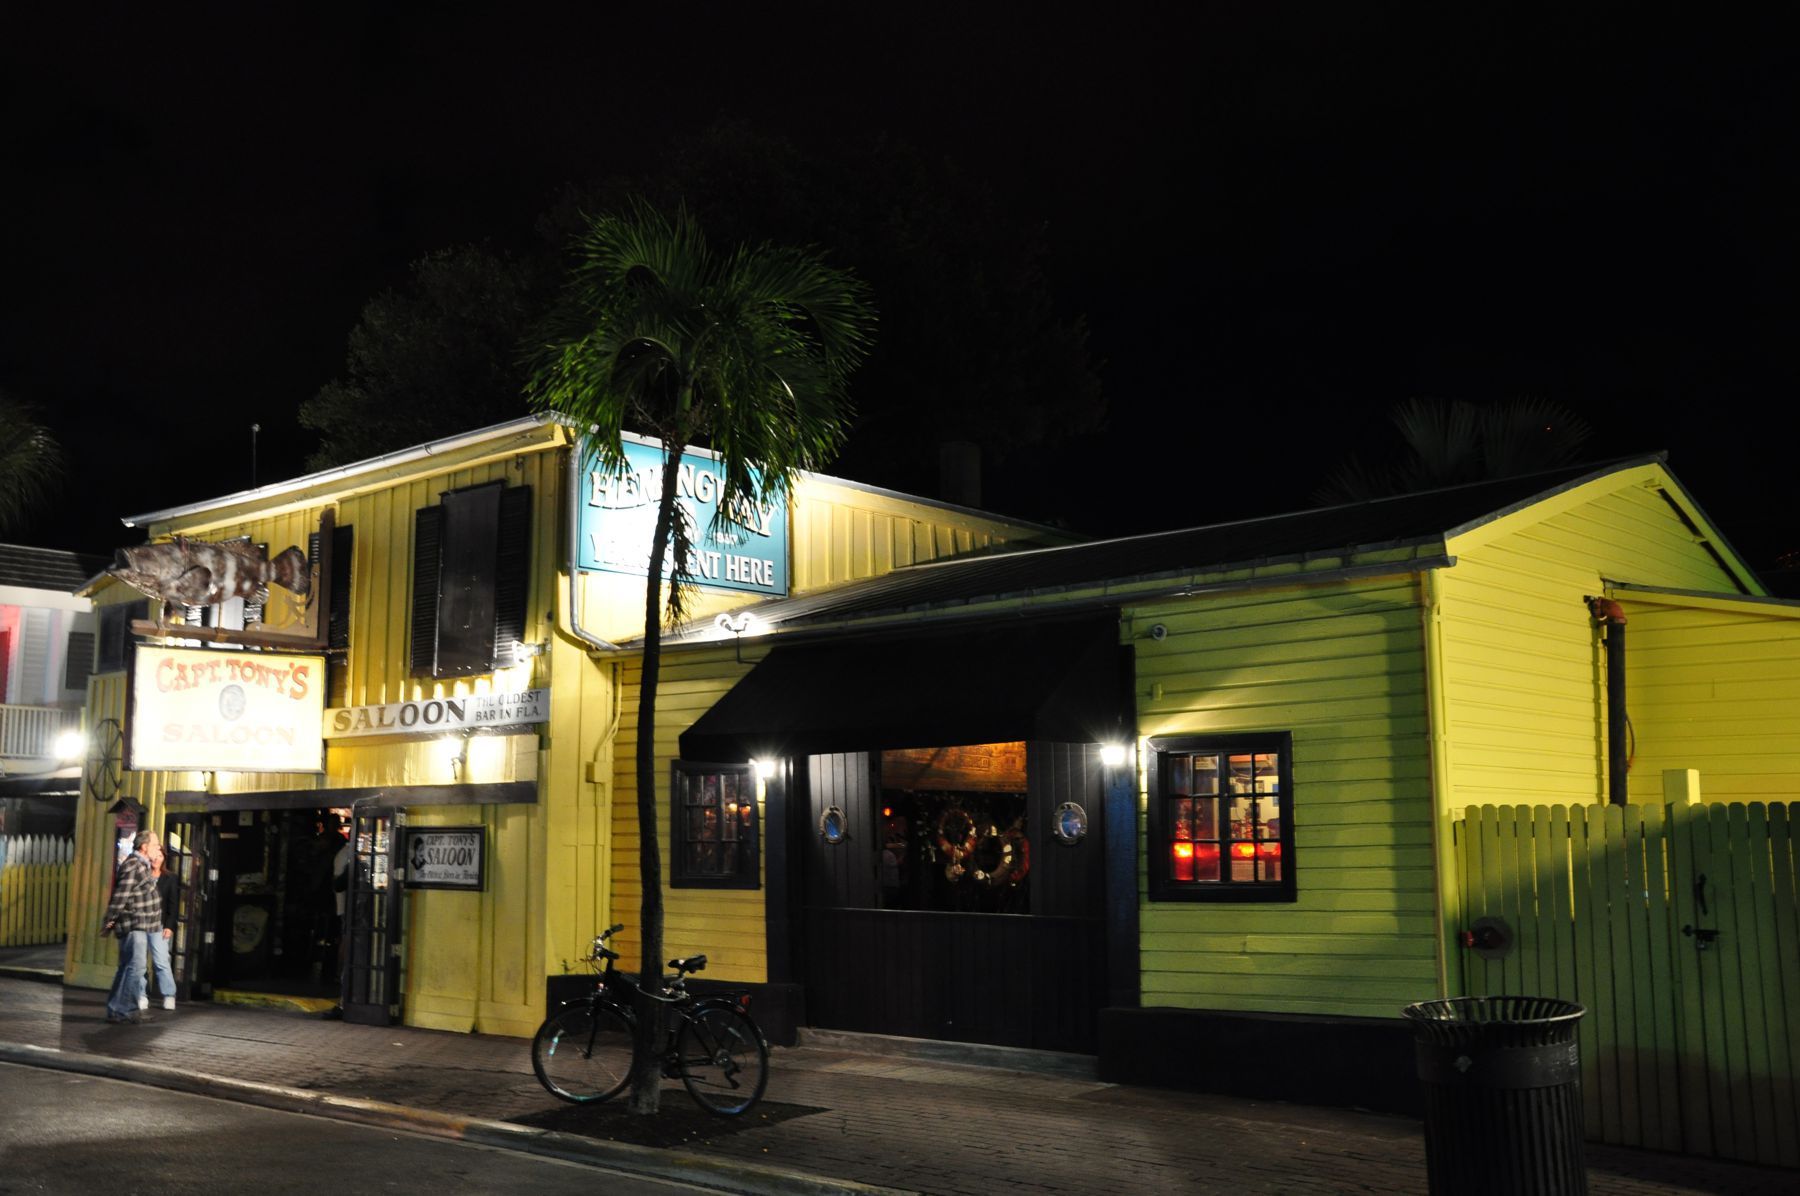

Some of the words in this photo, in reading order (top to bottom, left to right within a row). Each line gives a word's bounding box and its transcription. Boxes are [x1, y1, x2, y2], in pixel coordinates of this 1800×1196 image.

[724, 554, 775, 586] HERE
[155, 657, 222, 693] CAPT.
[225, 658, 310, 701] TONY'S
[498, 690, 542, 706] OLDEST
[333, 698, 467, 733] SALOON
[476, 709, 497, 721] BAR
[499, 707, 512, 720] IN
[161, 722, 296, 746] SALOON
[425, 835, 445, 847] CAPT.
[447, 834, 477, 847] TONY'S
[426, 847, 477, 866] SALOON
